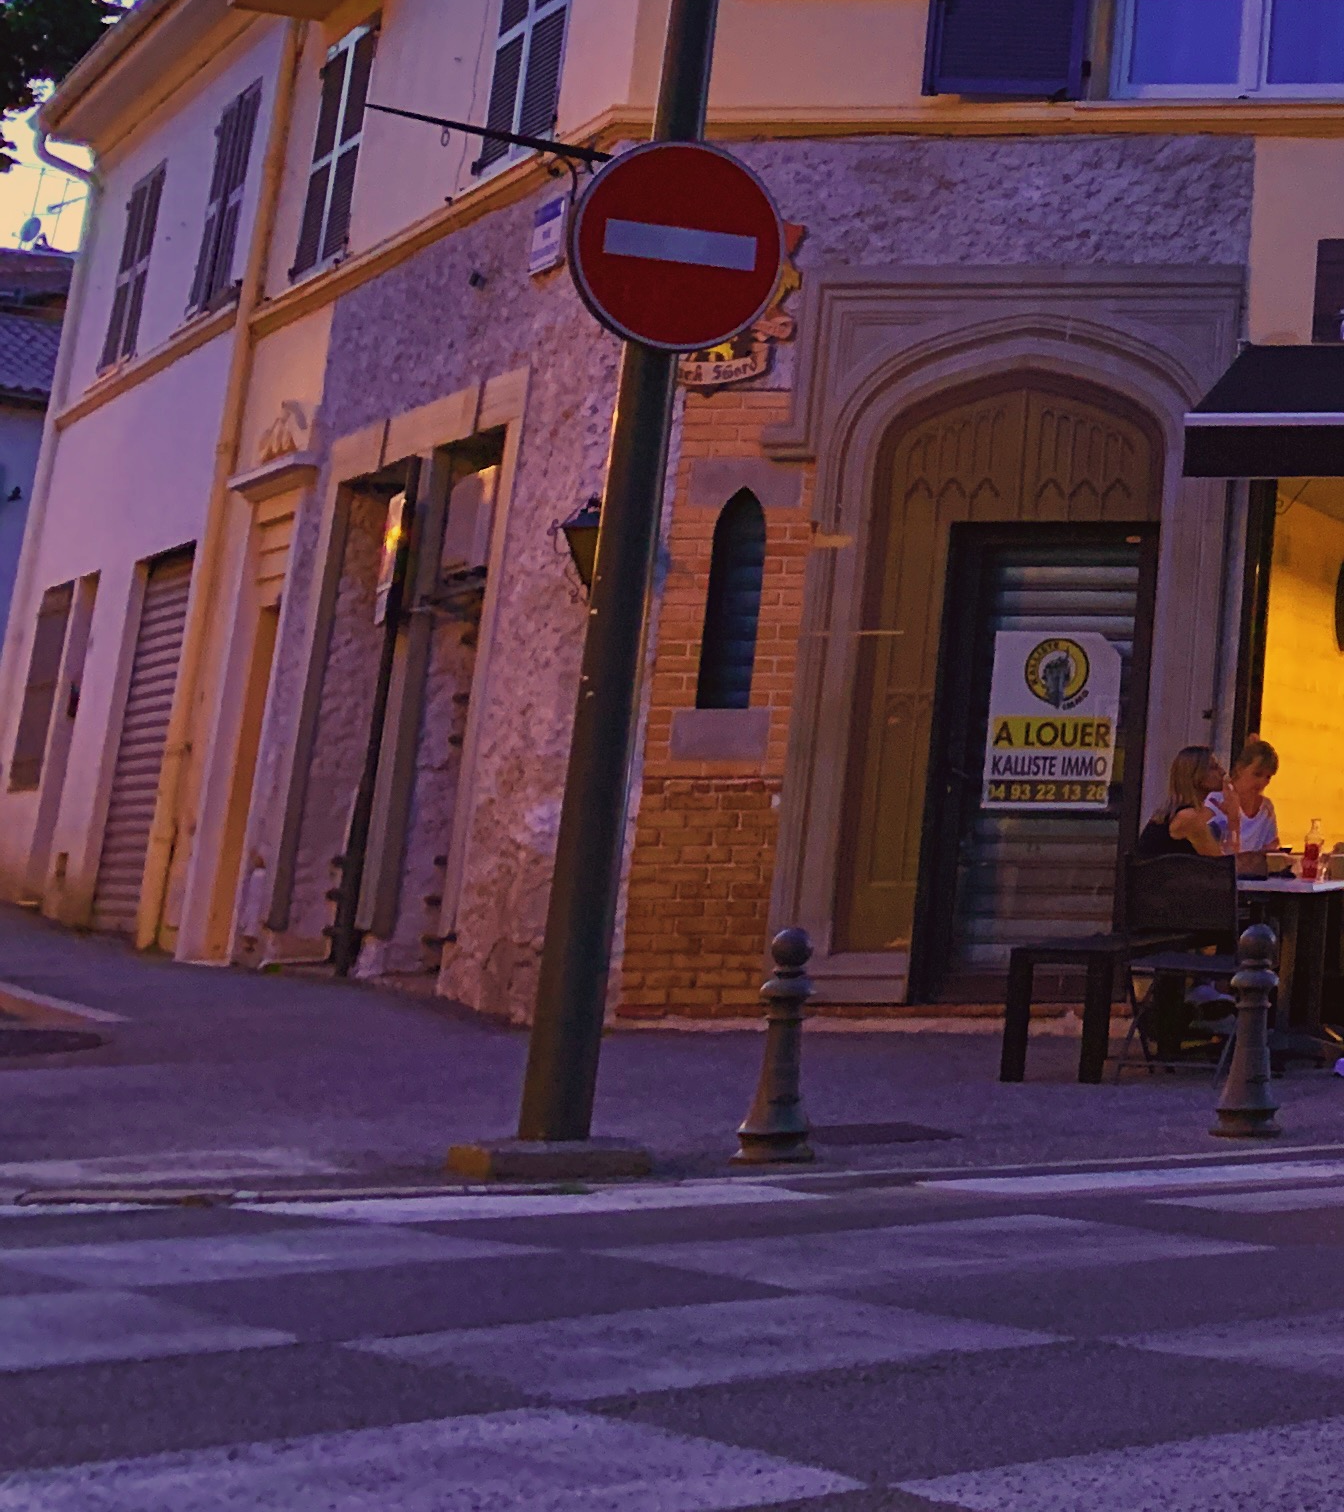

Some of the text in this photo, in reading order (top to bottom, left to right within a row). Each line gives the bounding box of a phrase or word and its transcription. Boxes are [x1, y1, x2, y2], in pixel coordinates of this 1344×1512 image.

[993, 721, 1111, 748] A LOUER
[991, 754, 1107, 777] KALLISTE IMMO
[1035, 783, 1056, 801] 22
[1062, 783, 1082, 801] 13
